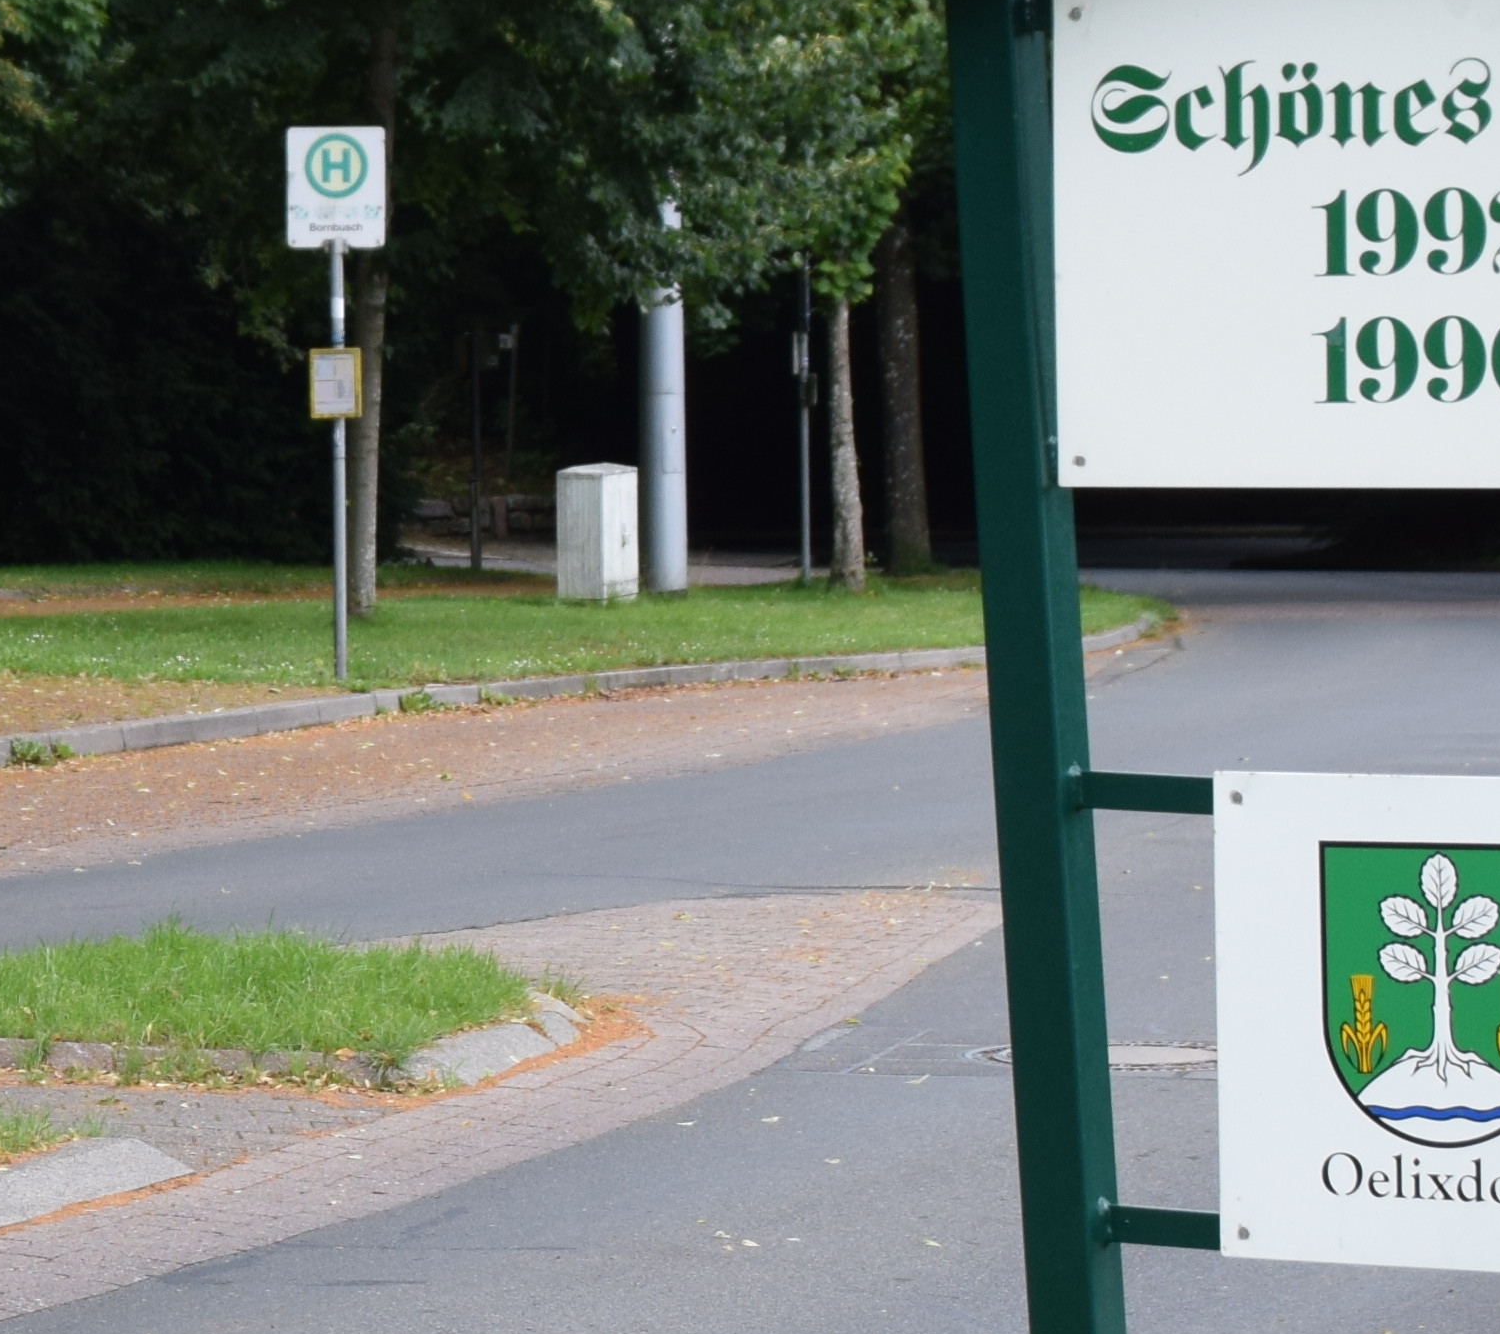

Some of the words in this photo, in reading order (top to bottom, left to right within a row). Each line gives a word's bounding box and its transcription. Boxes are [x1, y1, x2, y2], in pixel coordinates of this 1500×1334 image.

[1090, 57, 1493, 176] Schönes
[322, 148, 351, 183] H
[309, 223, 363, 232] Bornbusch
